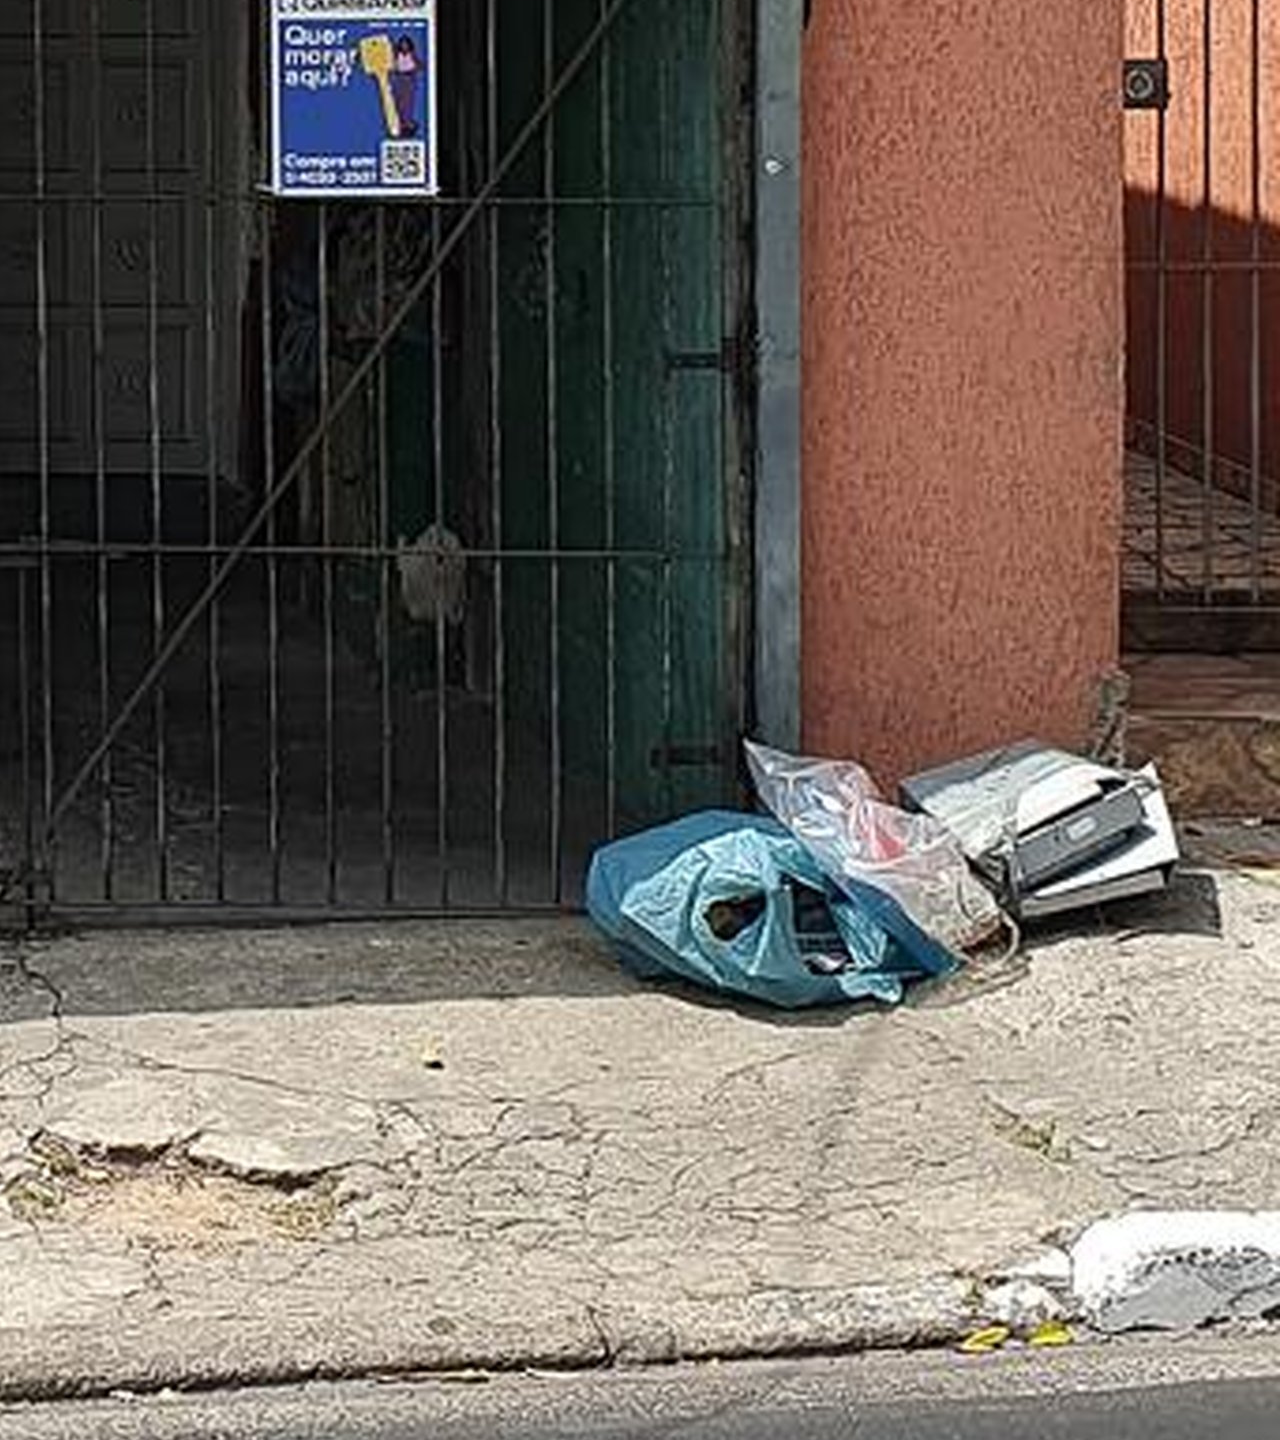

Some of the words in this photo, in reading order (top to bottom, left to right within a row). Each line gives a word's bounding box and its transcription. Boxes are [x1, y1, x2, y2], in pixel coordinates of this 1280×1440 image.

[285, 25, 347, 45] Quer
[285, 49, 357, 65] morar
[285, 65, 351, 90] aqui?
